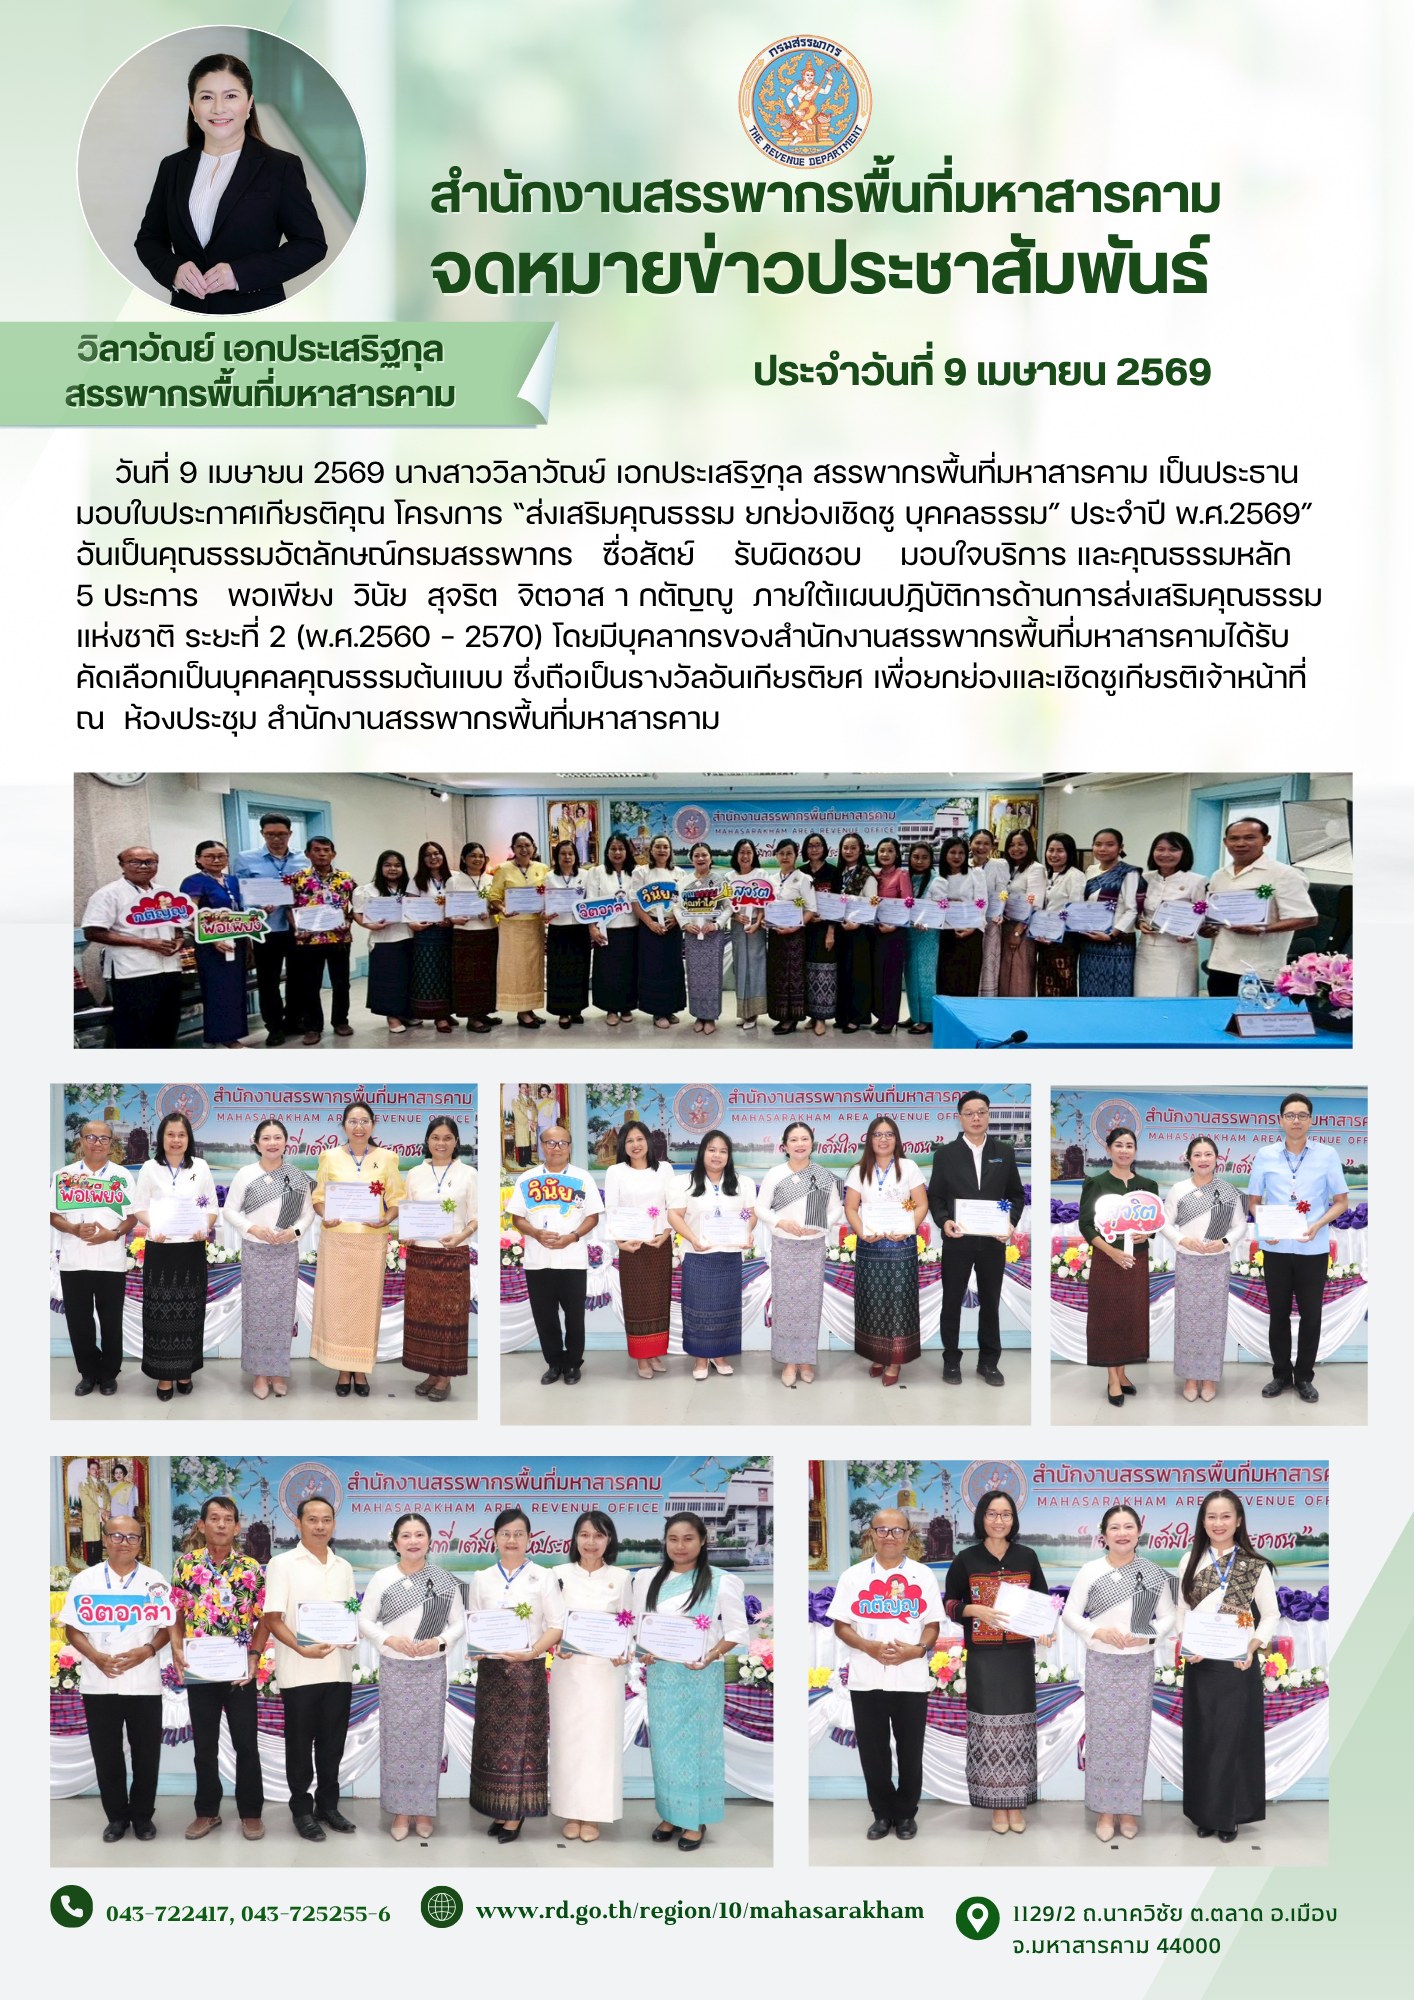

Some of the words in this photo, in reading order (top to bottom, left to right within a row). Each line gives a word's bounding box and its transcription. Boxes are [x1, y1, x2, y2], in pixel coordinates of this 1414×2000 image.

[213, 1085, 472, 1105] สำนักงานสรรพากรพื้นที่มหาสารคาม
[732, 1113, 831, 1122] MAHASARAKHAM
[838, 1113, 869, 1121] AREA
[60, 1183, 124, 1203] พอเพียง
[528, 1178, 574, 1202] วินัย
[347, 1467, 662, 1491] สำนักงานสรรพากรพื้นที่มหาสารคาม
[351, 1502, 475, 1513] MAHASARAKHAM
[608, 1502, 659, 1512] OFFICE
[78, 1597, 171, 1621] จิตอาสา
[859, 1594, 919, 1617] กตัญญู
